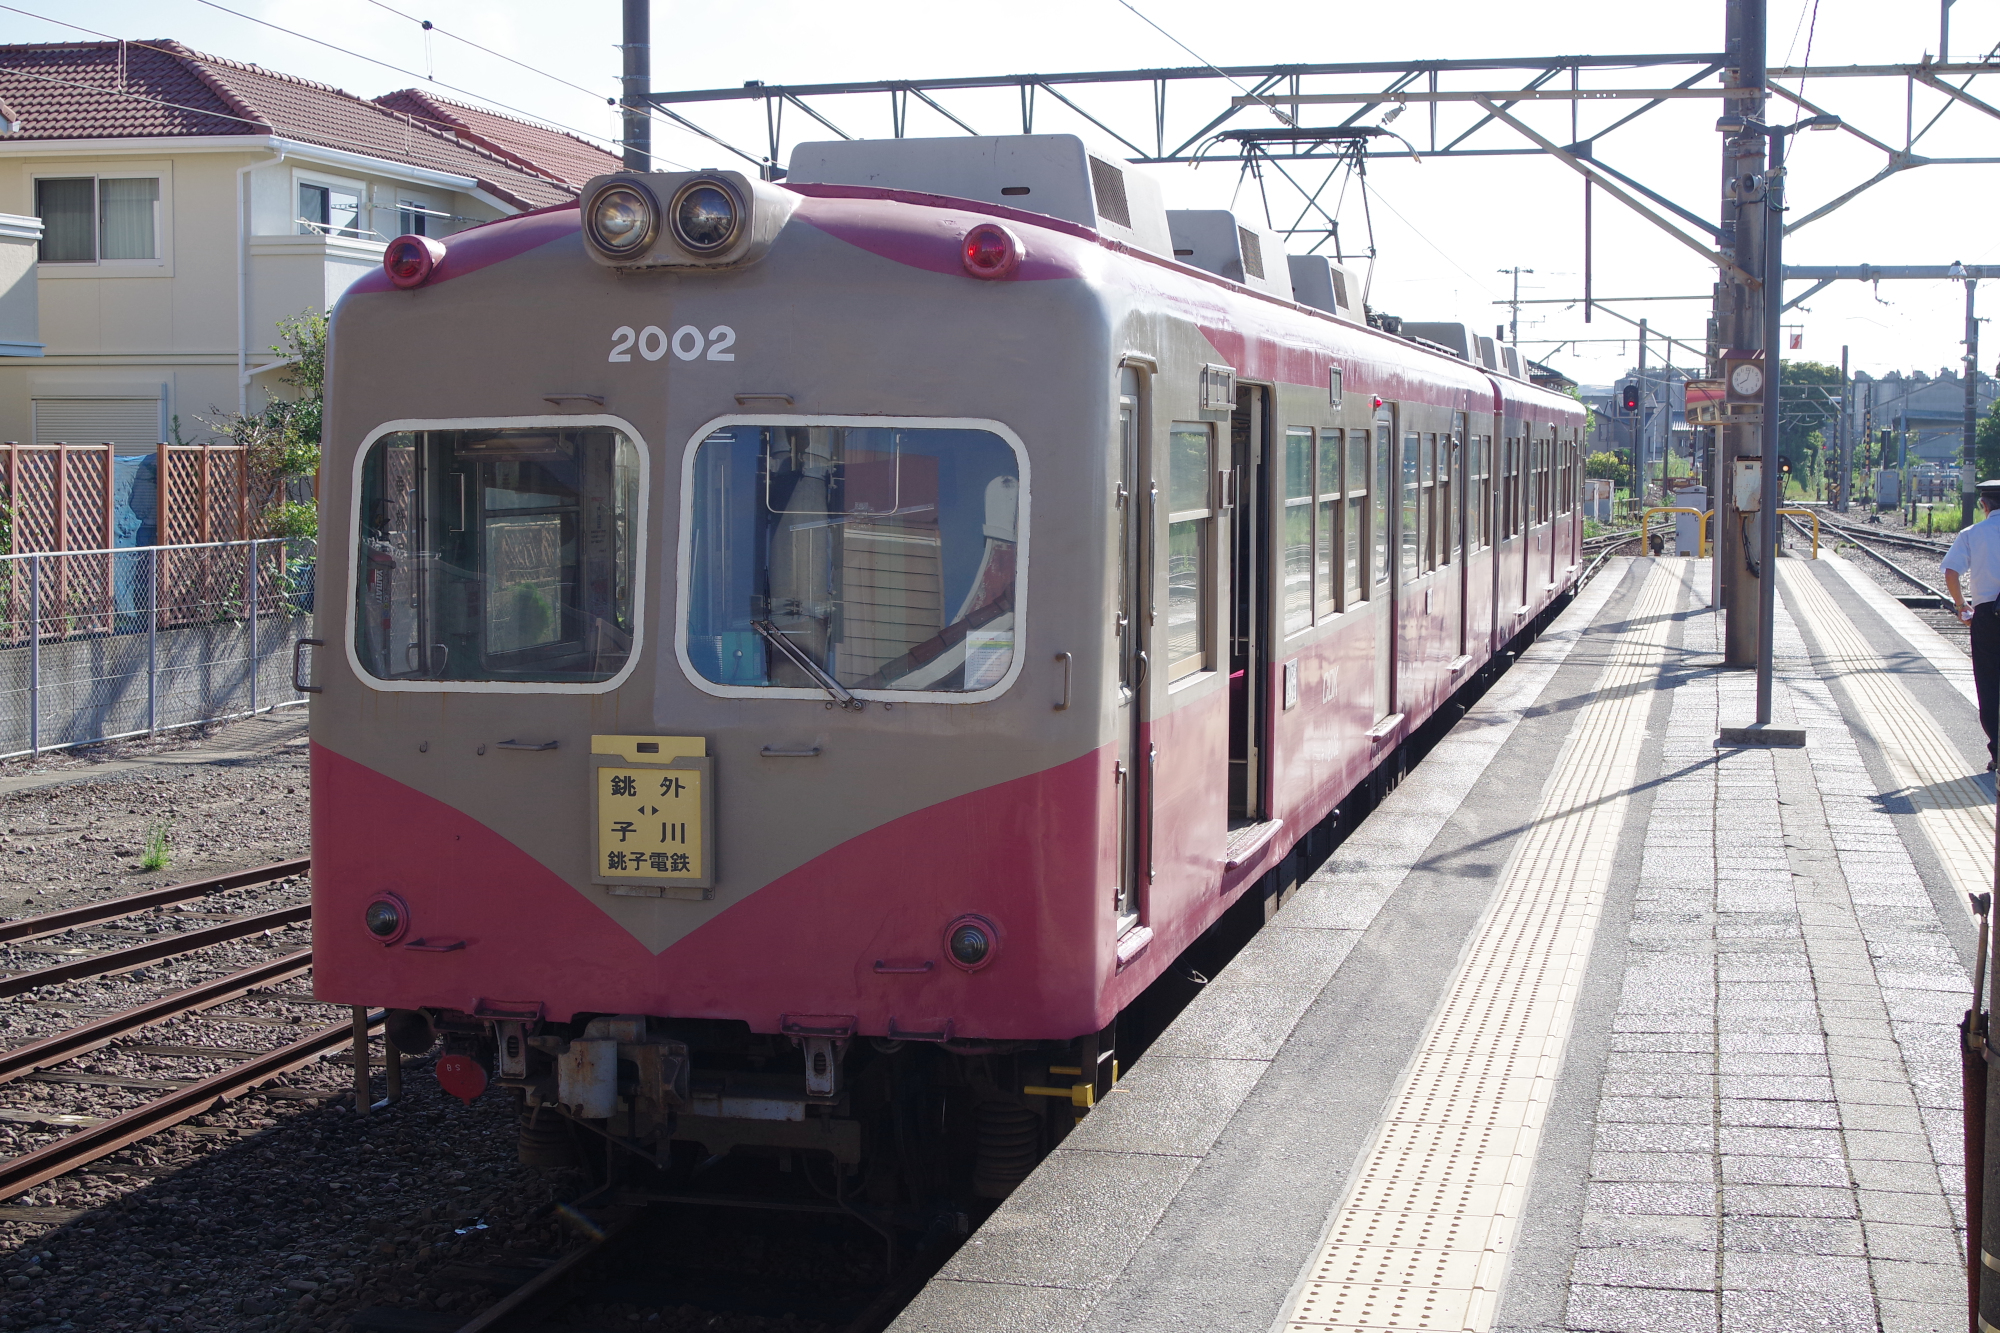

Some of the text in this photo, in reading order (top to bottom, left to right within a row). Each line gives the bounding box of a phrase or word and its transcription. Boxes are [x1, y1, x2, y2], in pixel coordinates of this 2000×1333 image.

[608, 325, 736, 362] 2002
[608, 851, 691, 872] 銚子電鉄
